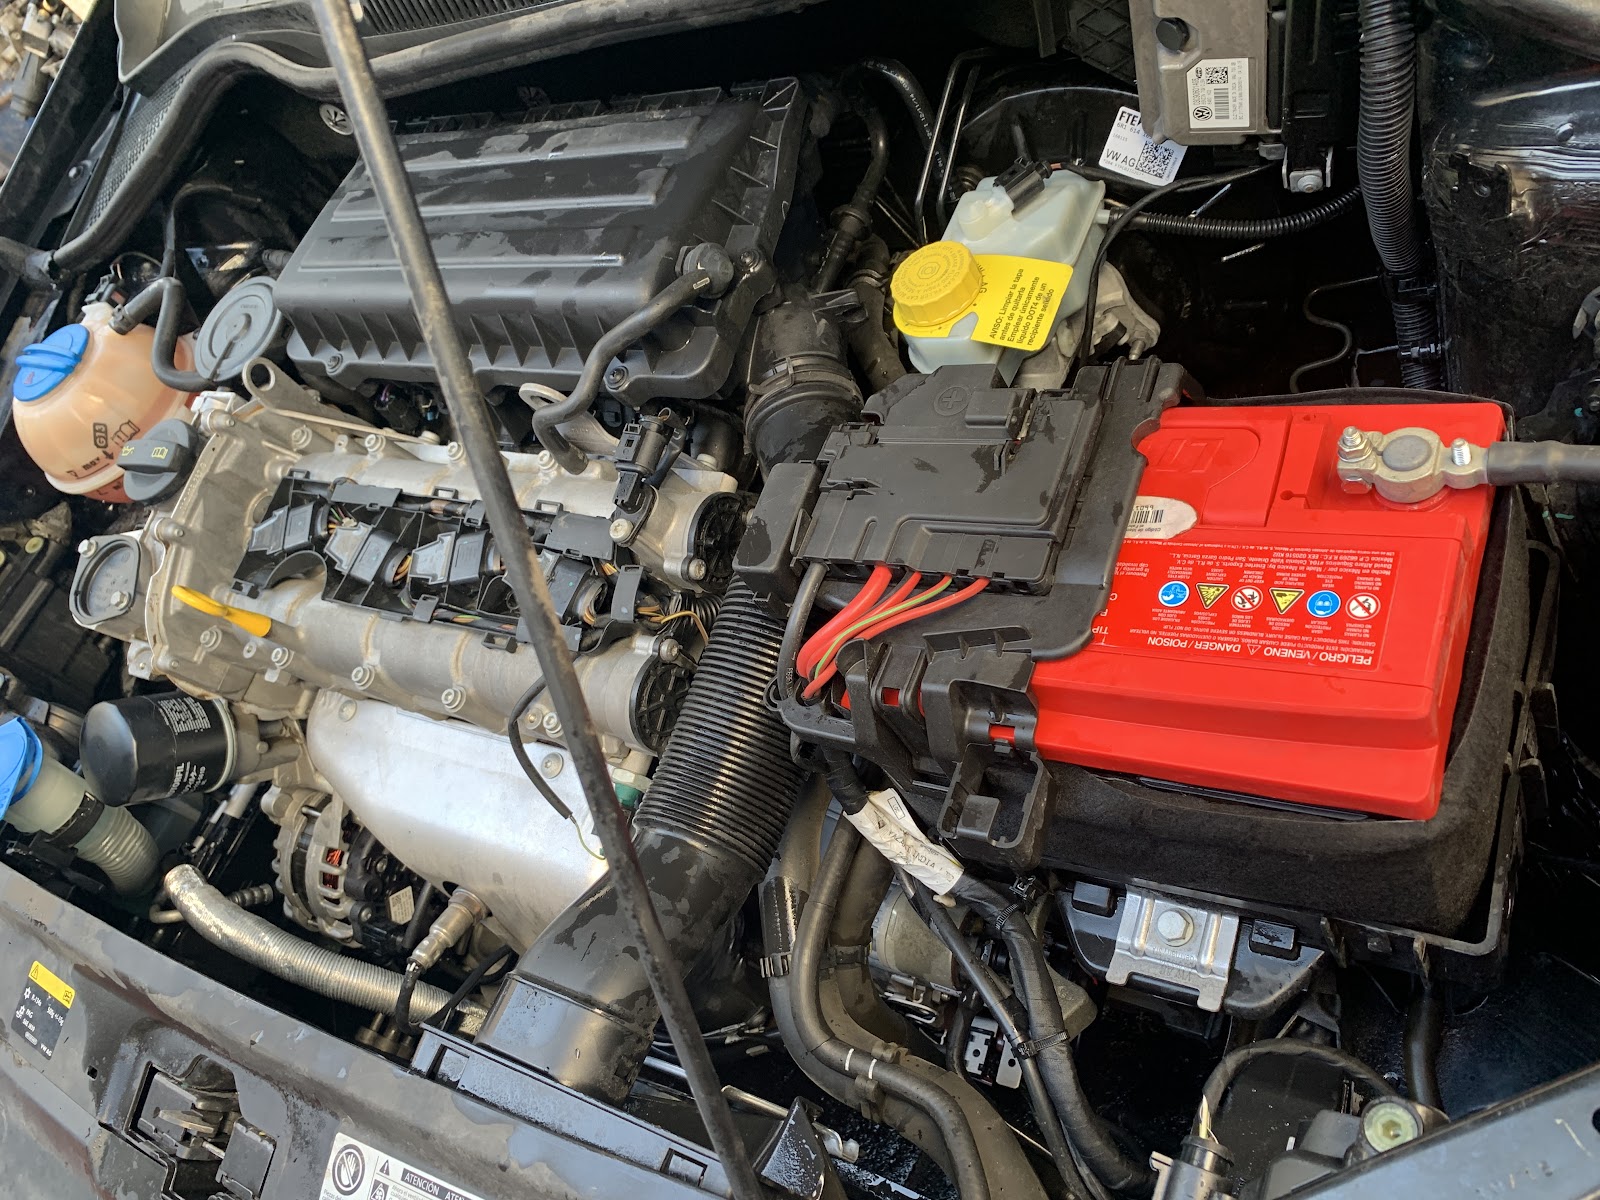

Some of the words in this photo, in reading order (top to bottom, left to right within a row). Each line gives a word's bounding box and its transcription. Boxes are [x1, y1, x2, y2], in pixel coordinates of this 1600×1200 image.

[1118, 110, 1138, 126] FTE
[1105, 148, 1121, 161] VW
[1120, 154, 1136, 167] AG
[998, 290, 1014, 316] Limpiar
[1009, 282, 1017, 290] la
[1013, 267, 1024, 283] tapa
[998, 321, 1011, 340] antes
[1006, 311, 1014, 321] de
[1010, 285, 1026, 311] quitarla
[1007, 314, 1024, 342] Emplear
[1018, 275, 1040, 314] únicamente
[1016, 320, 1032, 344] líquido
[1025, 300, 1039, 320] DOT4
[1034, 291, 1042, 301] de
[1039, 282, 1047, 291] un
[1026, 312, 1045, 346] recipiente
[95, 424, 105, 446] G13
[1147, 636, 1187, 648] POISON
[1194, 640, 1241, 653] DANGER
[1263, 646, 1310, 659] VENENO
[1319, 651, 1372, 665] PELIGRO
[404, 1172, 439, 1196] ATENCIÓN
